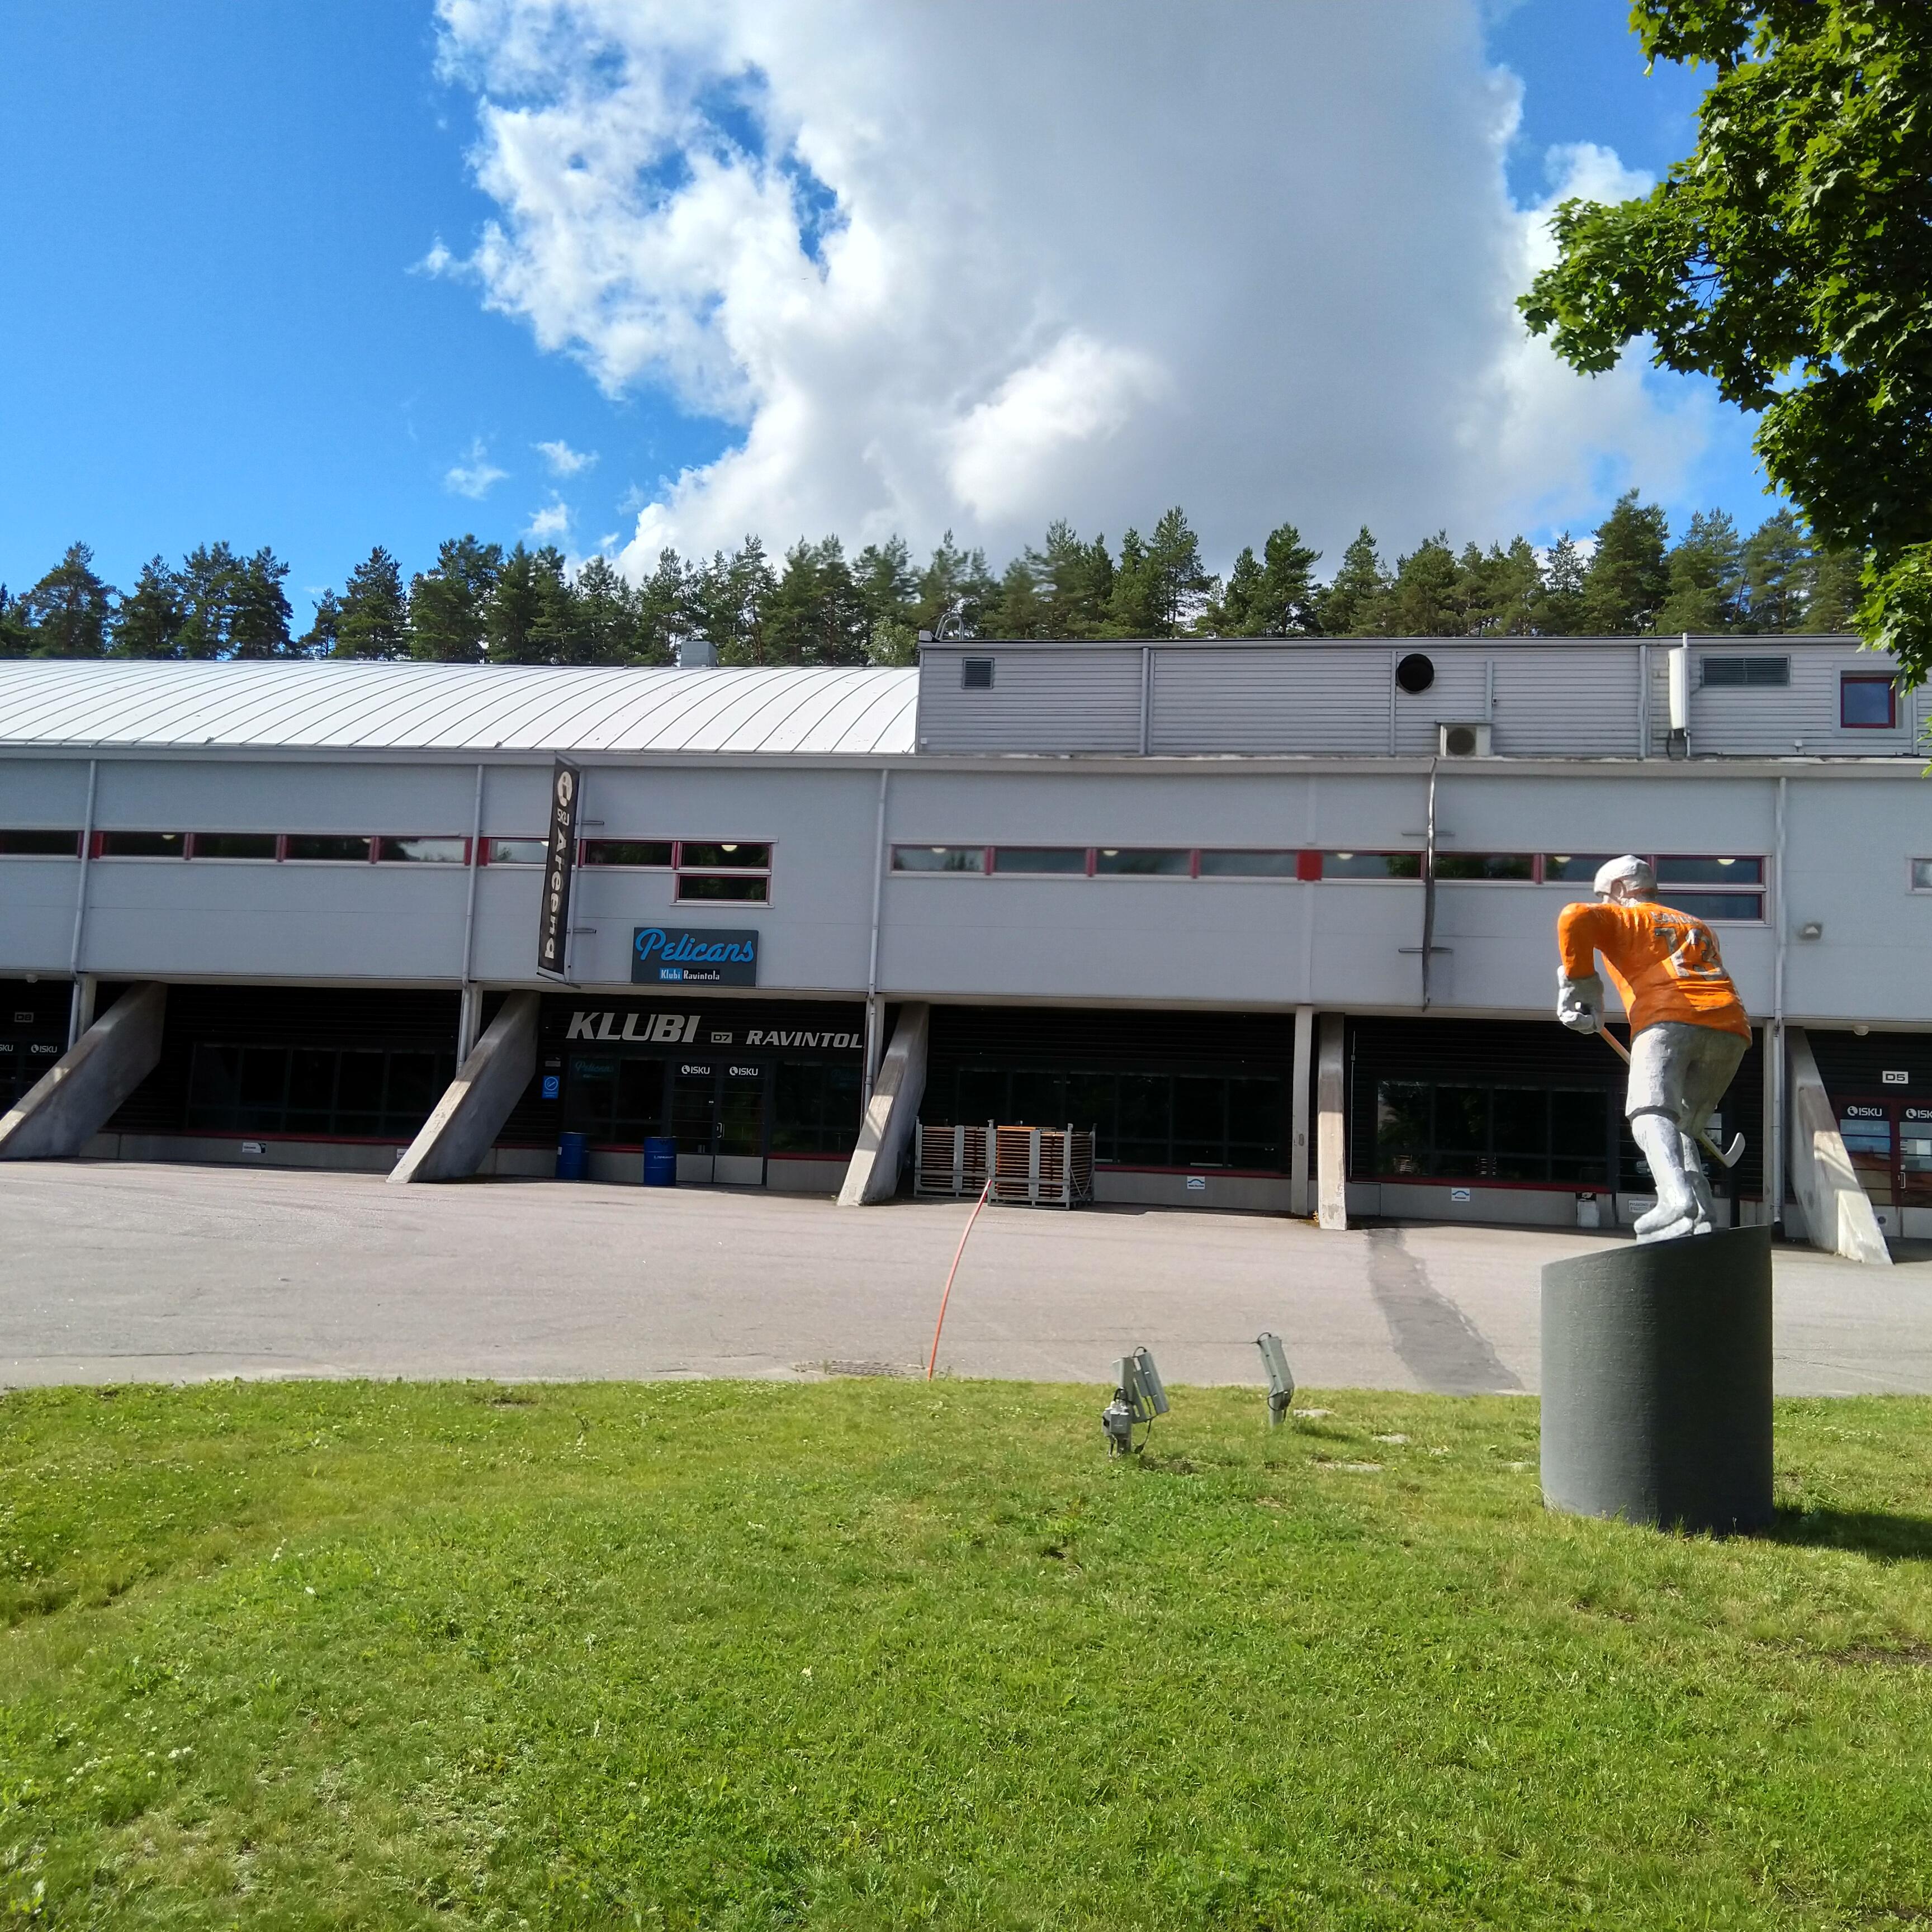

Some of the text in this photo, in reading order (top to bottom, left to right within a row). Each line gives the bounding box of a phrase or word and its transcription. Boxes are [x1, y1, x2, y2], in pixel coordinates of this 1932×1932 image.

[544, 826, 567, 959] Areena
[635, 928, 754, 963] Pelicans
[660, 969, 720, 980] Klubi Ravintola
[566, 1012, 701, 1043] KLUBI
[746, 1030, 865, 1048] RAVINTOL
[690, 1066, 710, 1074] ISKU
[1859, 1107, 1882, 1116] ISKU
[1917, 1110, 1932, 1119] ISK
